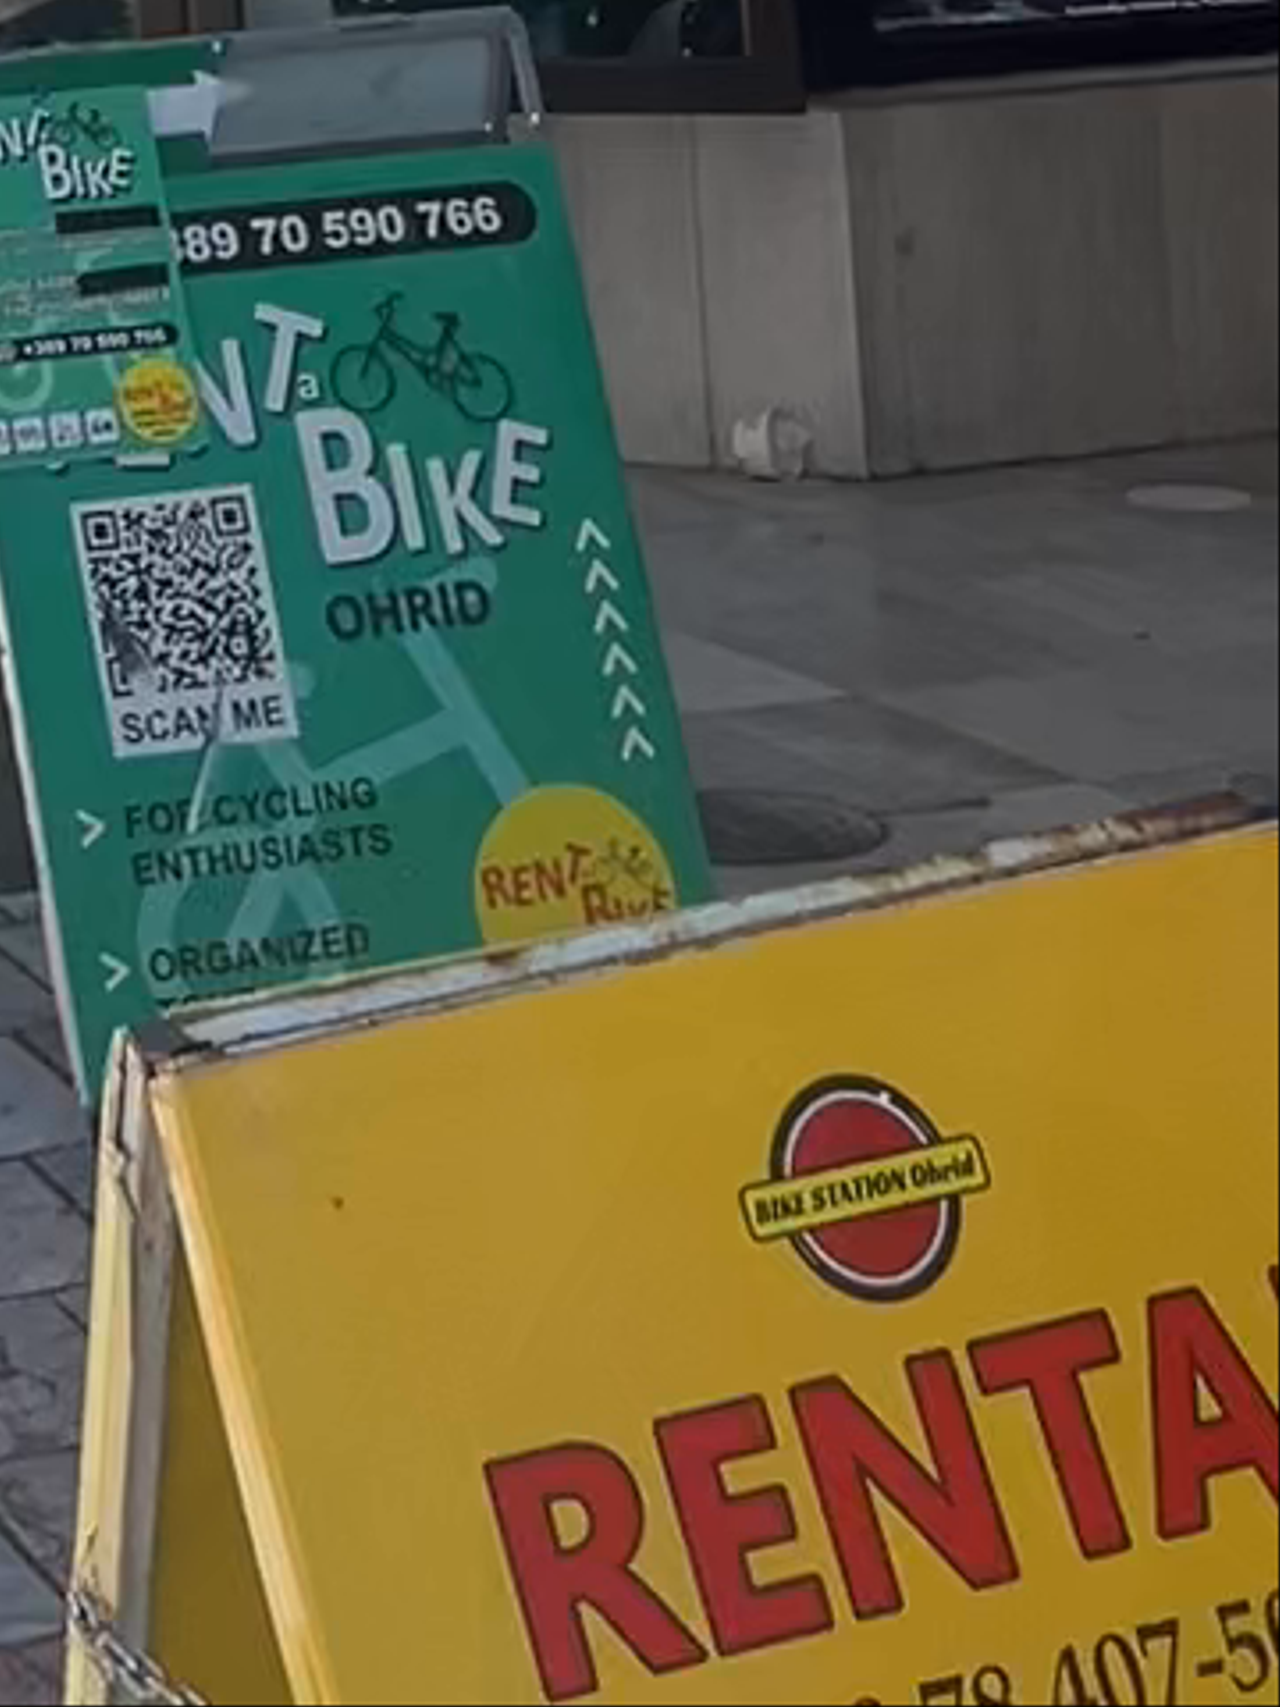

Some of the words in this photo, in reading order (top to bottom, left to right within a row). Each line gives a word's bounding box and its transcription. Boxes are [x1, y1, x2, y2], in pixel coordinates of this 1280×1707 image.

[38, 143, 135, 201] BIKE
[250, 215, 309, 255] 70
[321, 205, 406, 249] 590
[416, 196, 503, 239] 766
[296, 417, 550, 568] BIKE
[324, 580, 492, 645] OHRID
[121, 704, 219, 745] SCAN
[232, 695, 284, 730] ME
[211, 777, 378, 826] CYCLING
[130, 823, 394, 887] ENTHUSIASTS
[481, 841, 592, 910] RENT
[148, 922, 370, 981] ORGANIZED
[754, 1193, 805, 1225] BIKE
[810, 1166, 907, 1212] STATION
[911, 1151, 975, 1186] Ohrid
[483, 1264, 1278, 1702] RENTA
[1052, 1589, 1278, 1707] 407-5
